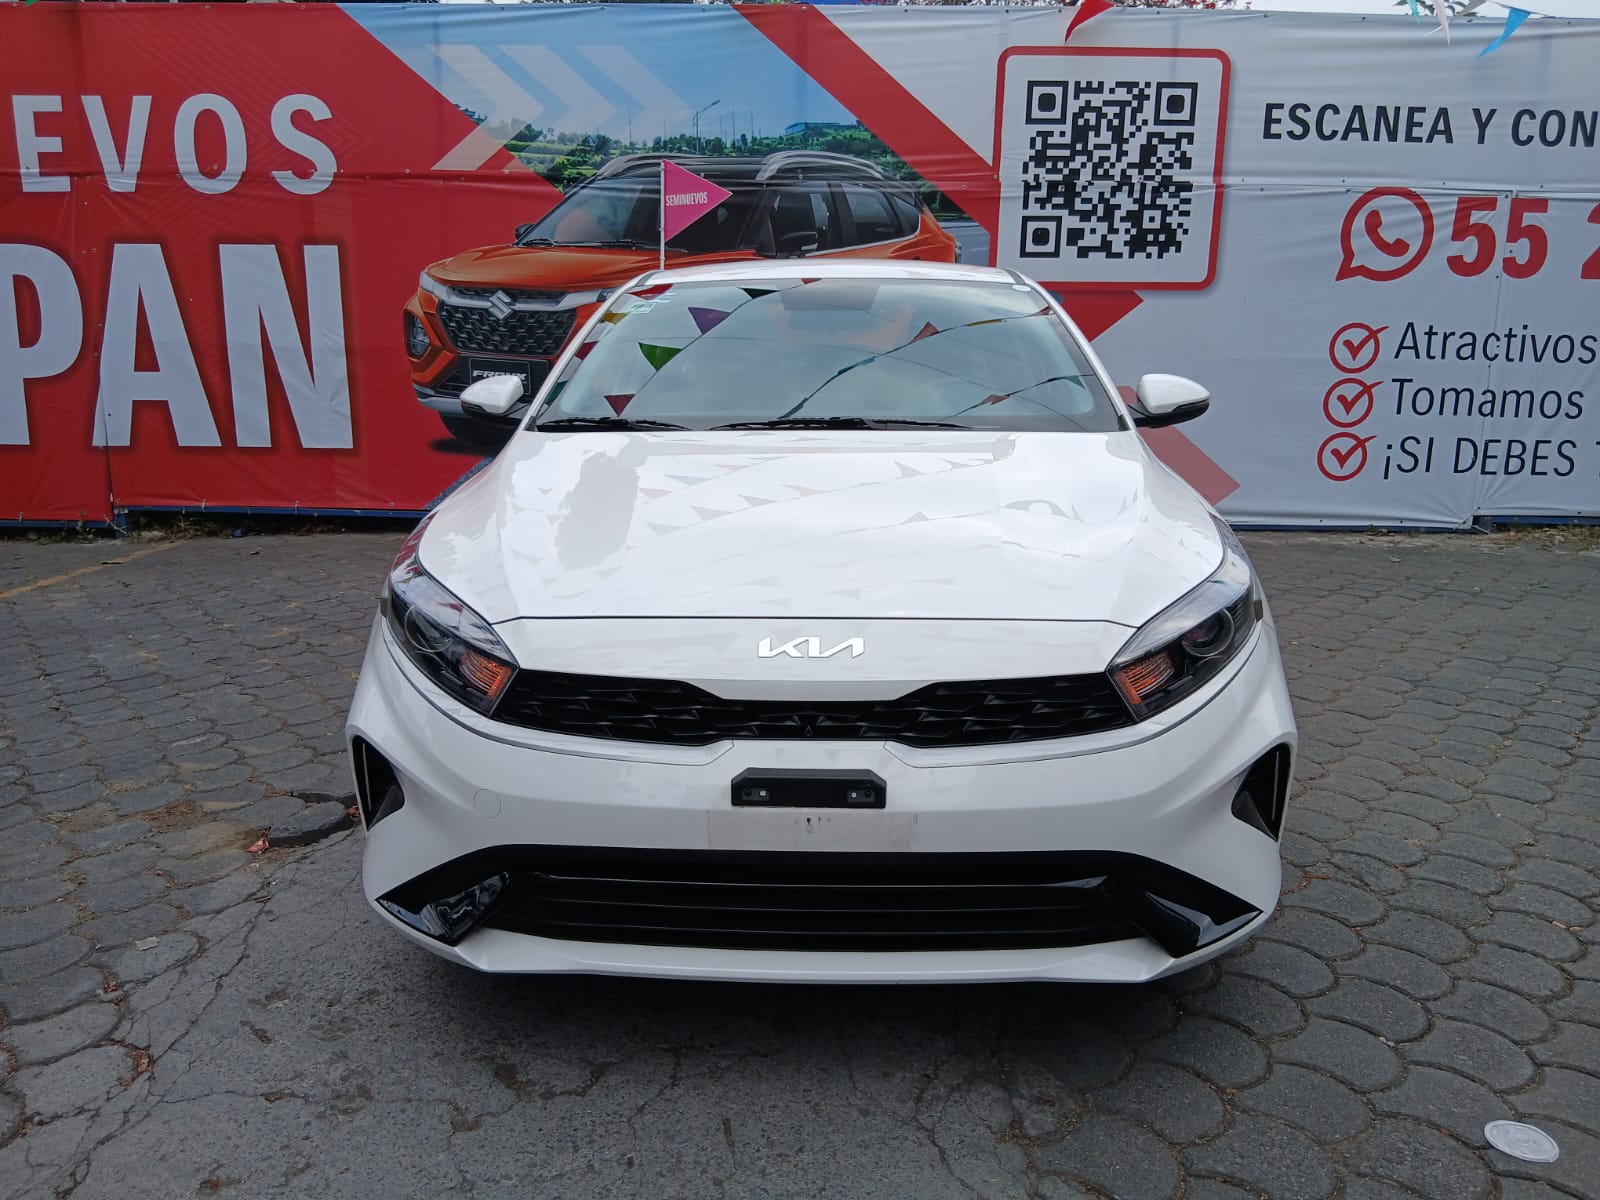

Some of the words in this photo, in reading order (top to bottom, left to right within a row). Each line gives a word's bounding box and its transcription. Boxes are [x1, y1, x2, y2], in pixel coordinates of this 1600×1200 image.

[12, 93, 338, 195] EVOS
[1263, 102, 1454, 144] ESCANEA
[1471, 108, 1497, 145] Y
[665, 192, 708, 206] SEMINUEVOS
[1446, 197, 1549, 278] 55
[0, 243, 353, 449] PAN
[1393, 322, 1598, 364] Atractivos
[1391, 378, 1586, 420] Tomamos
[1383, 436, 1435, 480] ¡SI
[1453, 438, 1577, 477] DEBES
[758, 637, 865, 659] KIA
